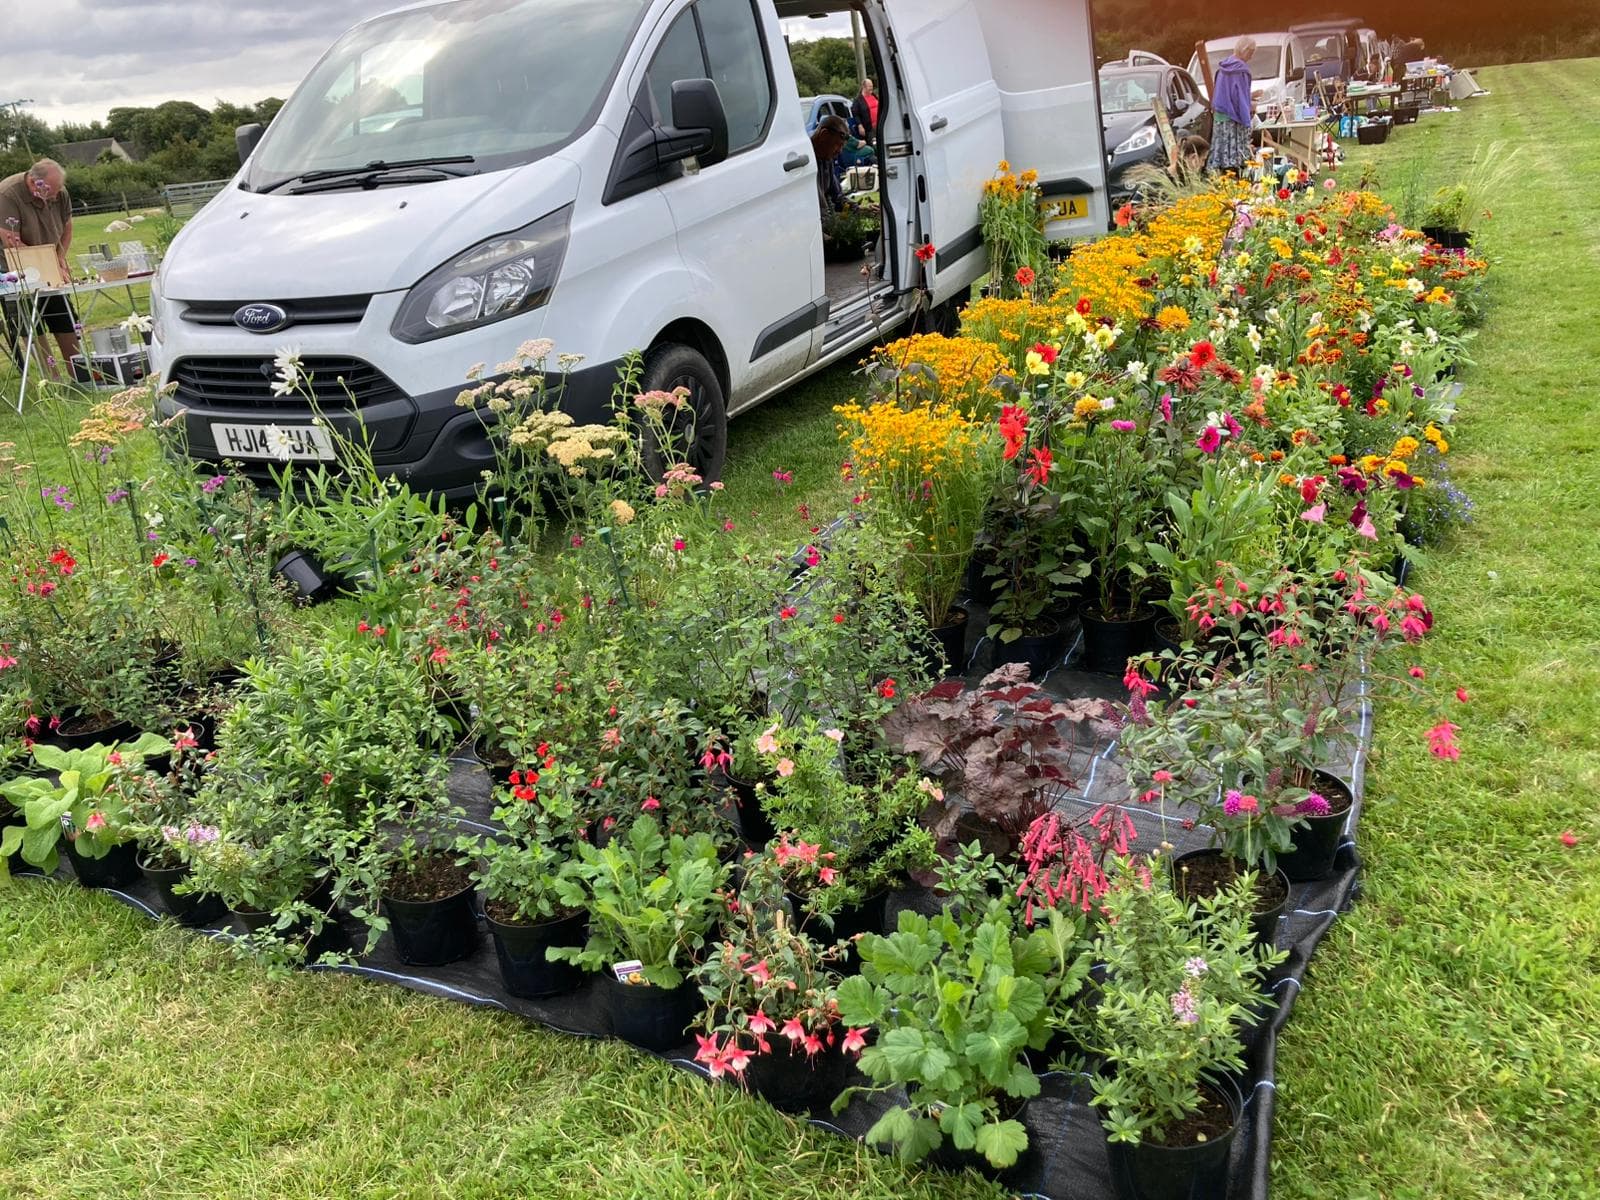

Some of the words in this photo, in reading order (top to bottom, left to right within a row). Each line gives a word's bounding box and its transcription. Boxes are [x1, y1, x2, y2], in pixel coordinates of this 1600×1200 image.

[1047, 200, 1078, 217] UA
[242, 308, 271, 324] Ford
[276, 429, 319, 455] UA
